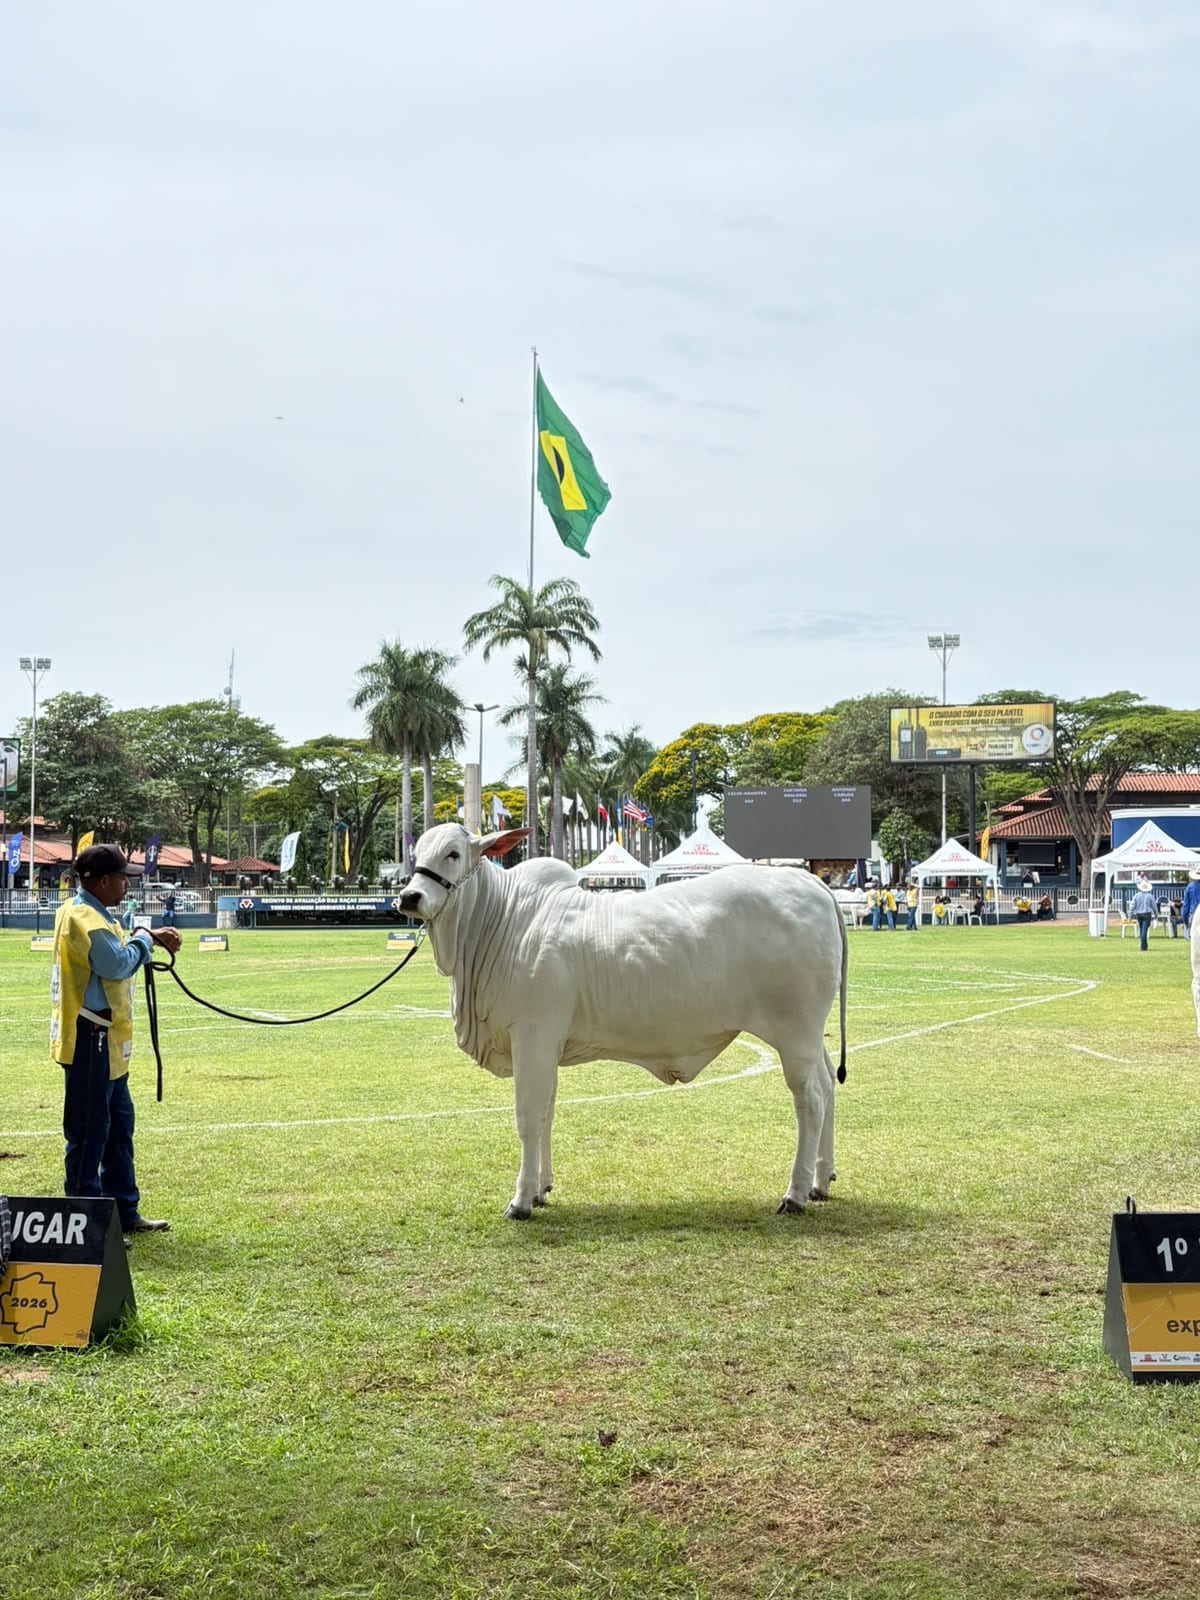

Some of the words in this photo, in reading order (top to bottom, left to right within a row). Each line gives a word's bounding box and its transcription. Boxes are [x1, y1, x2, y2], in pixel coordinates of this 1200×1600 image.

[935, 711, 962, 719] CUIDADO
[962, 710, 978, 718] COM
[997, 708, 1024, 717] PLANTEL
[1157, 1237, 1188, 1272] 1º
[11, 1297, 47, 1309] 2026
